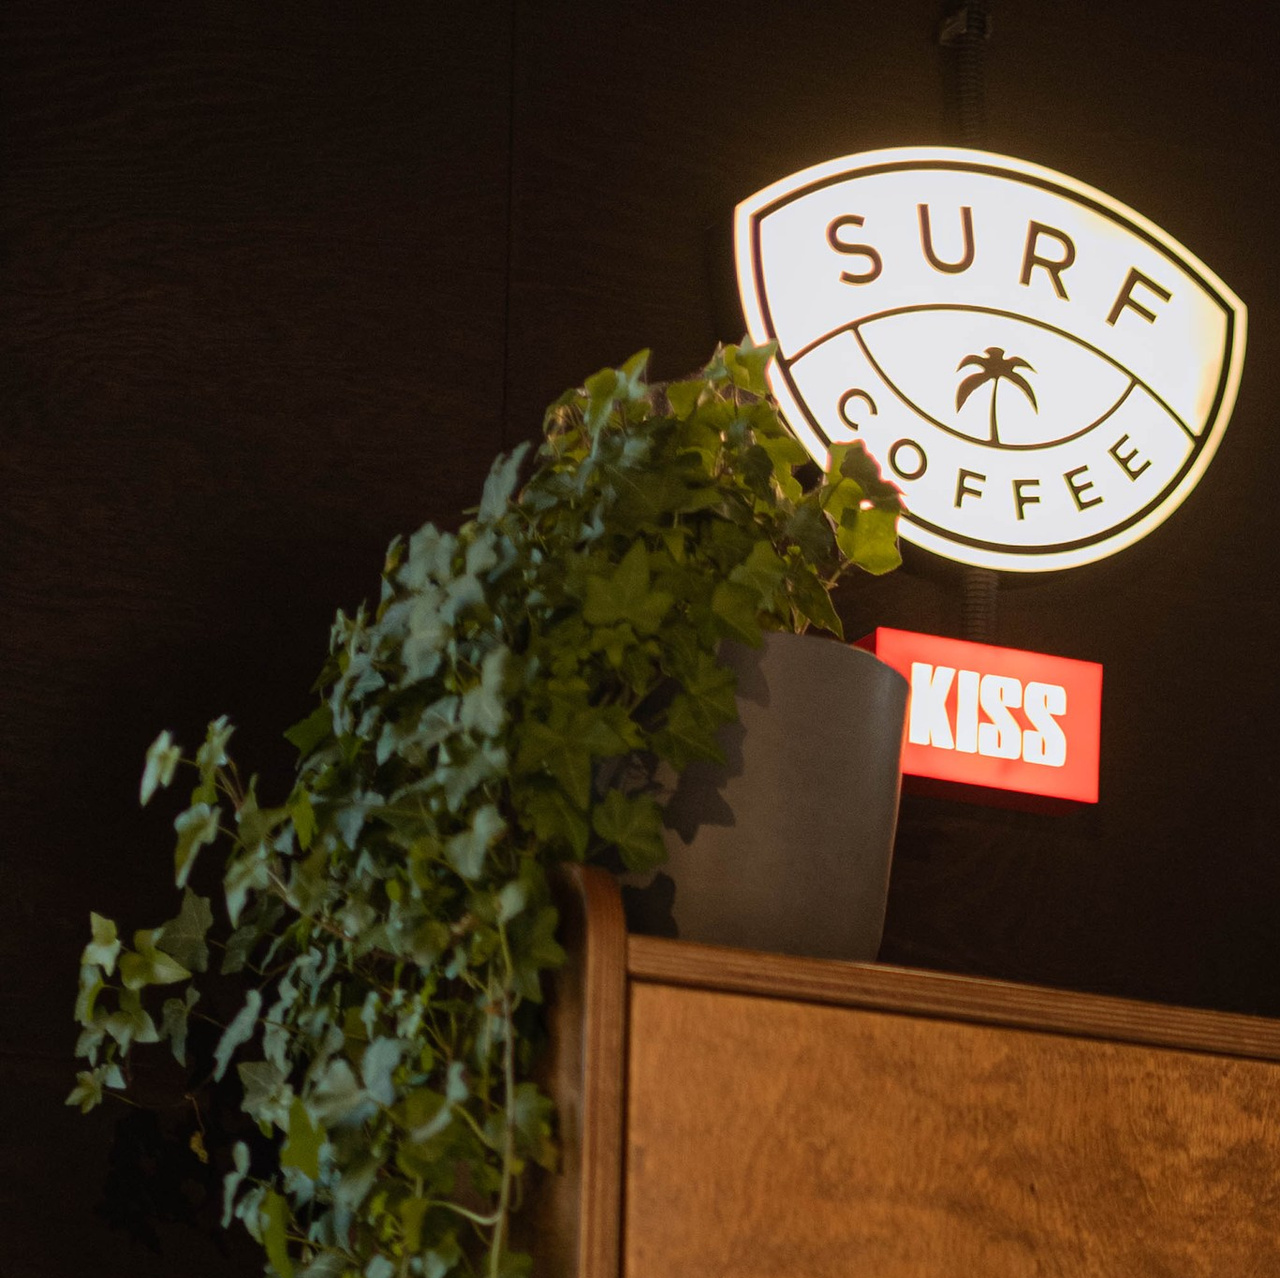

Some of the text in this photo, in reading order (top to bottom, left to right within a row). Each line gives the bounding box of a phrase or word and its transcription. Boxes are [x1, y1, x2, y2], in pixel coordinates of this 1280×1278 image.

[826, 203, 1172, 326] SURF
[838, 387, 1151, 520] COFFEE
[909, 661, 1067, 768] KISS
